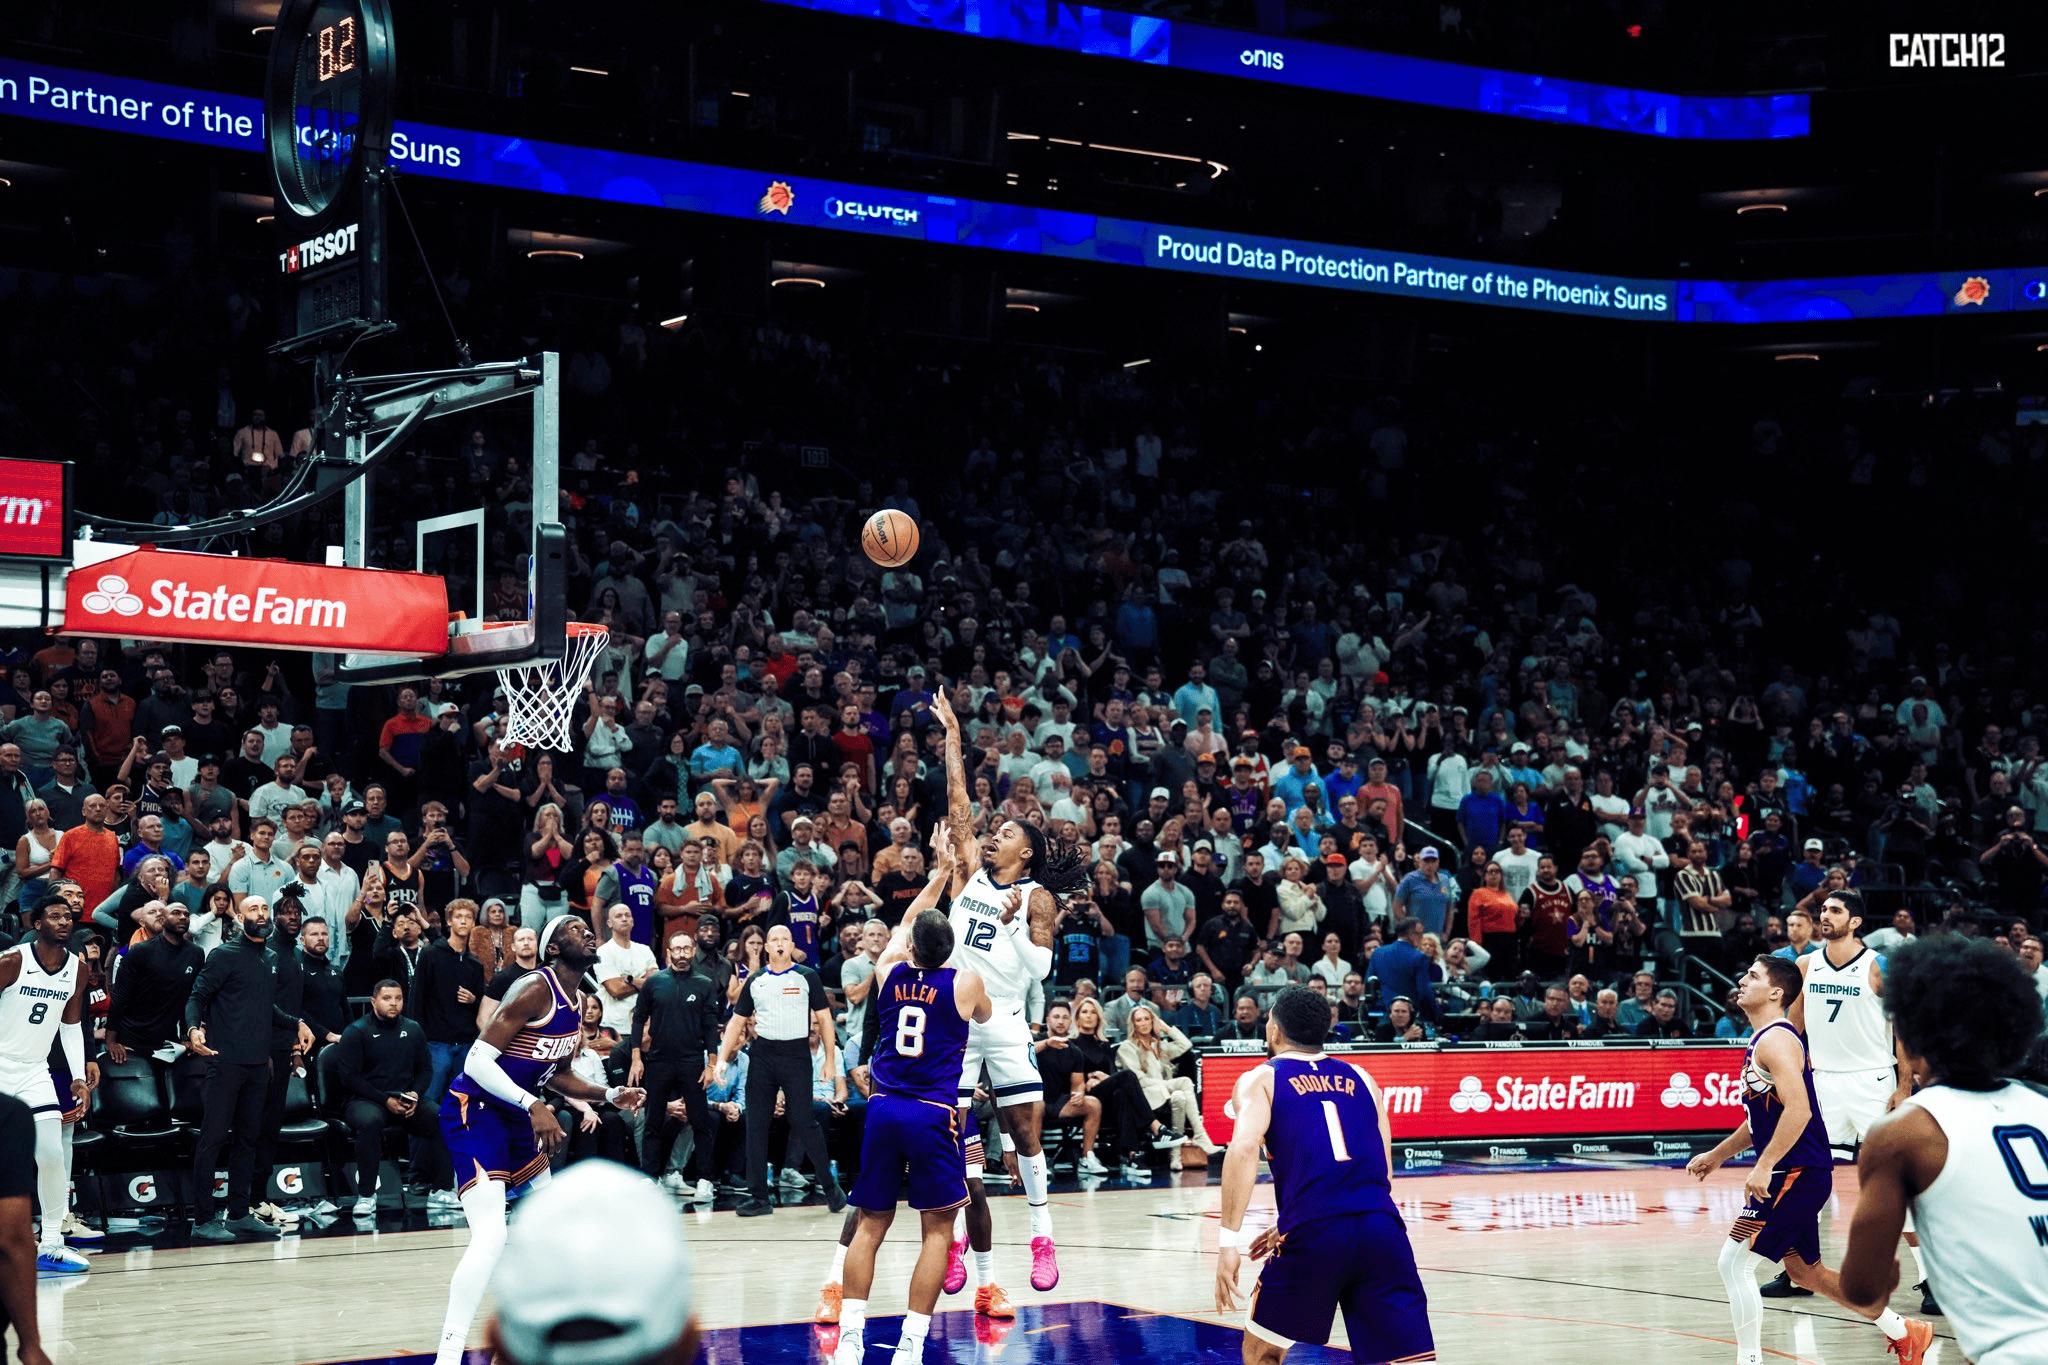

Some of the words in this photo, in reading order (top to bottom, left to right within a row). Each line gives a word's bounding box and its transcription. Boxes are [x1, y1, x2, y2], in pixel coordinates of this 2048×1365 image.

[319, 16, 354, 82] 8.2
[28, 76, 153, 122] Partner
[161, 101, 195, 128] of
[201, 105, 253, 137] the
[389, 132, 461, 168] Suns
[844, 201, 918, 223] CLUTCH
[299, 223, 359, 268] TISSOT
[1157, 234, 1222, 264] Proud
[1226, 242, 1276, 270] Data
[1281, 249, 1389, 283] Protection
[1393, 262, 1468, 292] Partner
[1471, 271, 1494, 294] of
[1496, 275, 1529, 299] the
[1532, 277, 1610, 308] Phoenix
[1613, 285, 1668, 312] Suns
[964, 918, 998, 951] 12
[19, 985, 70, 1001] MEMPHIS
[894, 983, 939, 1005] ALLEN
[1809, 983, 1861, 997] MEMPHIS
[28, 1002, 49, 1025] 8
[1826, 999, 1844, 1023] 7
[895, 1005, 927, 1058] 8
[1289, 1074, 1356, 1097] BOOKER
[1320, 1100, 1352, 1162] 1
[1415, 1150, 1444, 1159] FANDUEL
[1500, 1147, 1528, 1155] FANDUEL
[1582, 1144, 1610, 1152] FANDUEL
